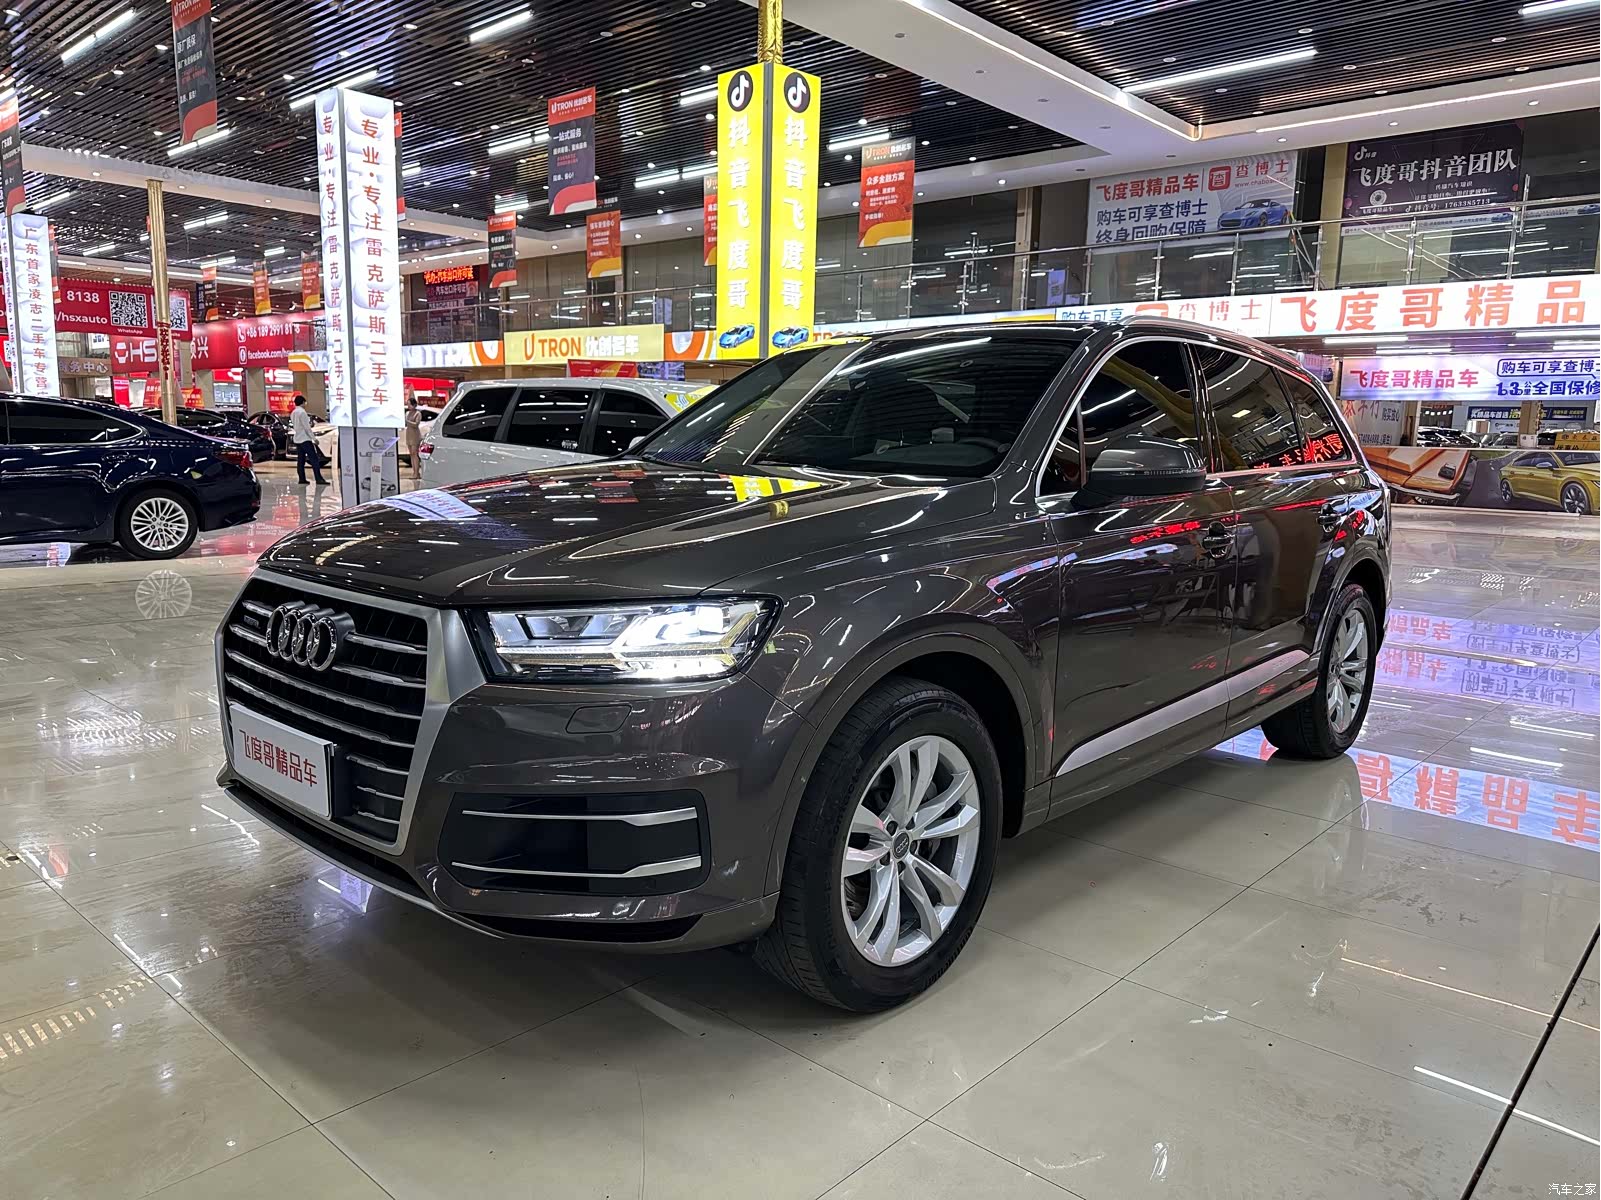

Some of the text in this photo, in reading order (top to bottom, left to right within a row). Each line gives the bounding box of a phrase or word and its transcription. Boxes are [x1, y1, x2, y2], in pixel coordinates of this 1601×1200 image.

[551, 99, 573, 114] UTRON
[1235, 159, 1290, 180] 查博士
[1353, 148, 1517, 187] 飞度哥抖音团队
[1096, 173, 1200, 201] 飞度哥精品车
[727, 115, 751, 309] 抖音飞度哥
[781, 115, 808, 311] 抖音飞度哥
[1096, 198, 1209, 227] 购车可享查博士
[66, 290, 100, 303] 8138
[1280, 280, 1586, 333] 飞度哥精品
[24, 228, 49, 395] 广东首家凌志二手车专营
[54, 312, 108, 324] /hsxauto
[585, 334, 639, 357] 优创名车
[1349, 368, 1479, 389] 飞度哥精品车
[239, 729, 318, 787] 飞度哥精品车
